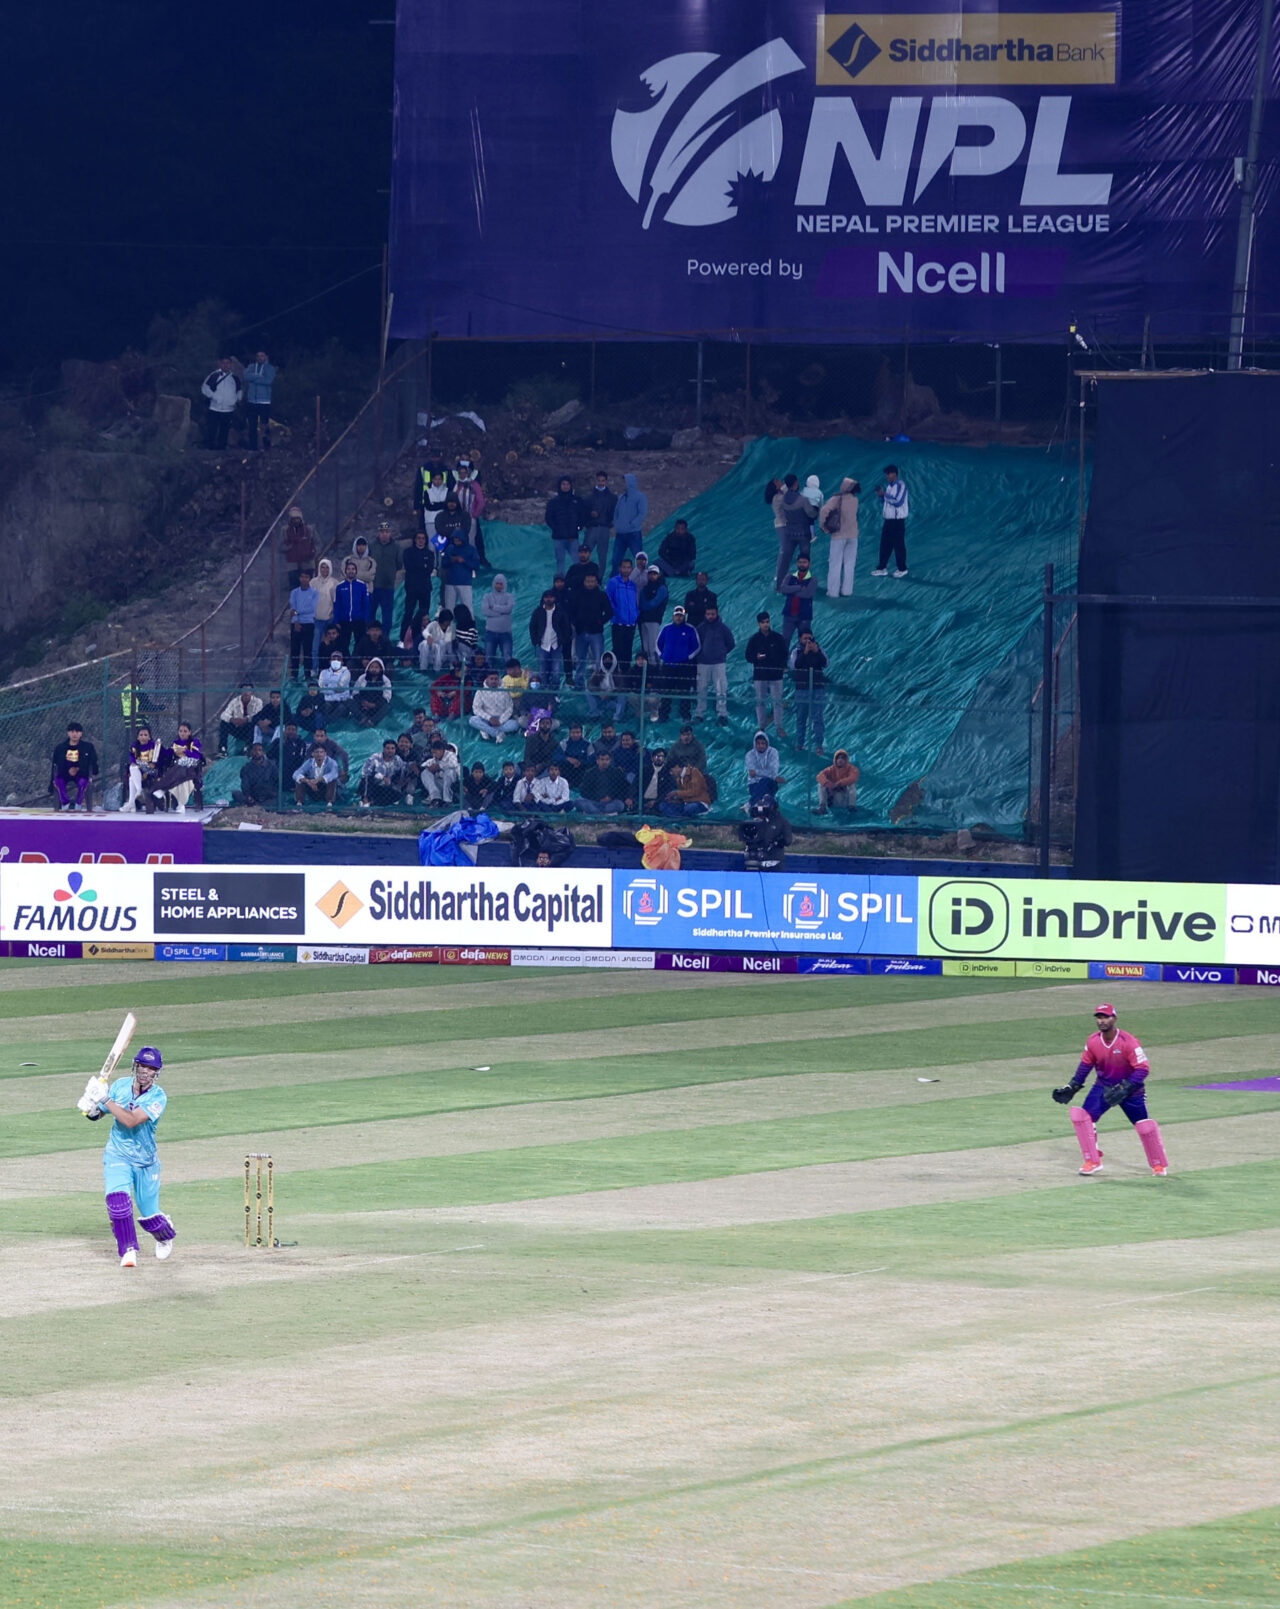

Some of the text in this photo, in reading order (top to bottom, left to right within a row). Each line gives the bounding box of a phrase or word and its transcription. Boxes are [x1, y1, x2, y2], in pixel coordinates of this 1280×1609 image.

[794, 96, 1114, 206] NPL
[797, 214, 1110, 233] NEPAL PREMIER LEAGUE
[687, 258, 803, 280] Powered by
[878, 252, 1005, 293] Ncell
[161, 888, 219, 901] STEEL &
[677, 888, 753, 919] SPIL
[838, 892, 913, 923] SPIL
[13, 905, 138, 932] FAMOUS
[161, 907, 298, 920] HOME APPLIANCES
[1022, 897, 1216, 942] inDrive
[693, 928, 844, 941] Siddhartha Premier Insurance Ltd.
[28, 944, 66, 957] Ncell
[672, 954, 710, 969] Ncell
[743, 957, 780, 971] Ncell
[971, 964, 999, 972] inDrive
[1044, 965, 1071, 973] inDrive
[1106, 966, 1143, 976] WAI WAI
[1177, 967, 1222, 982] vivo
